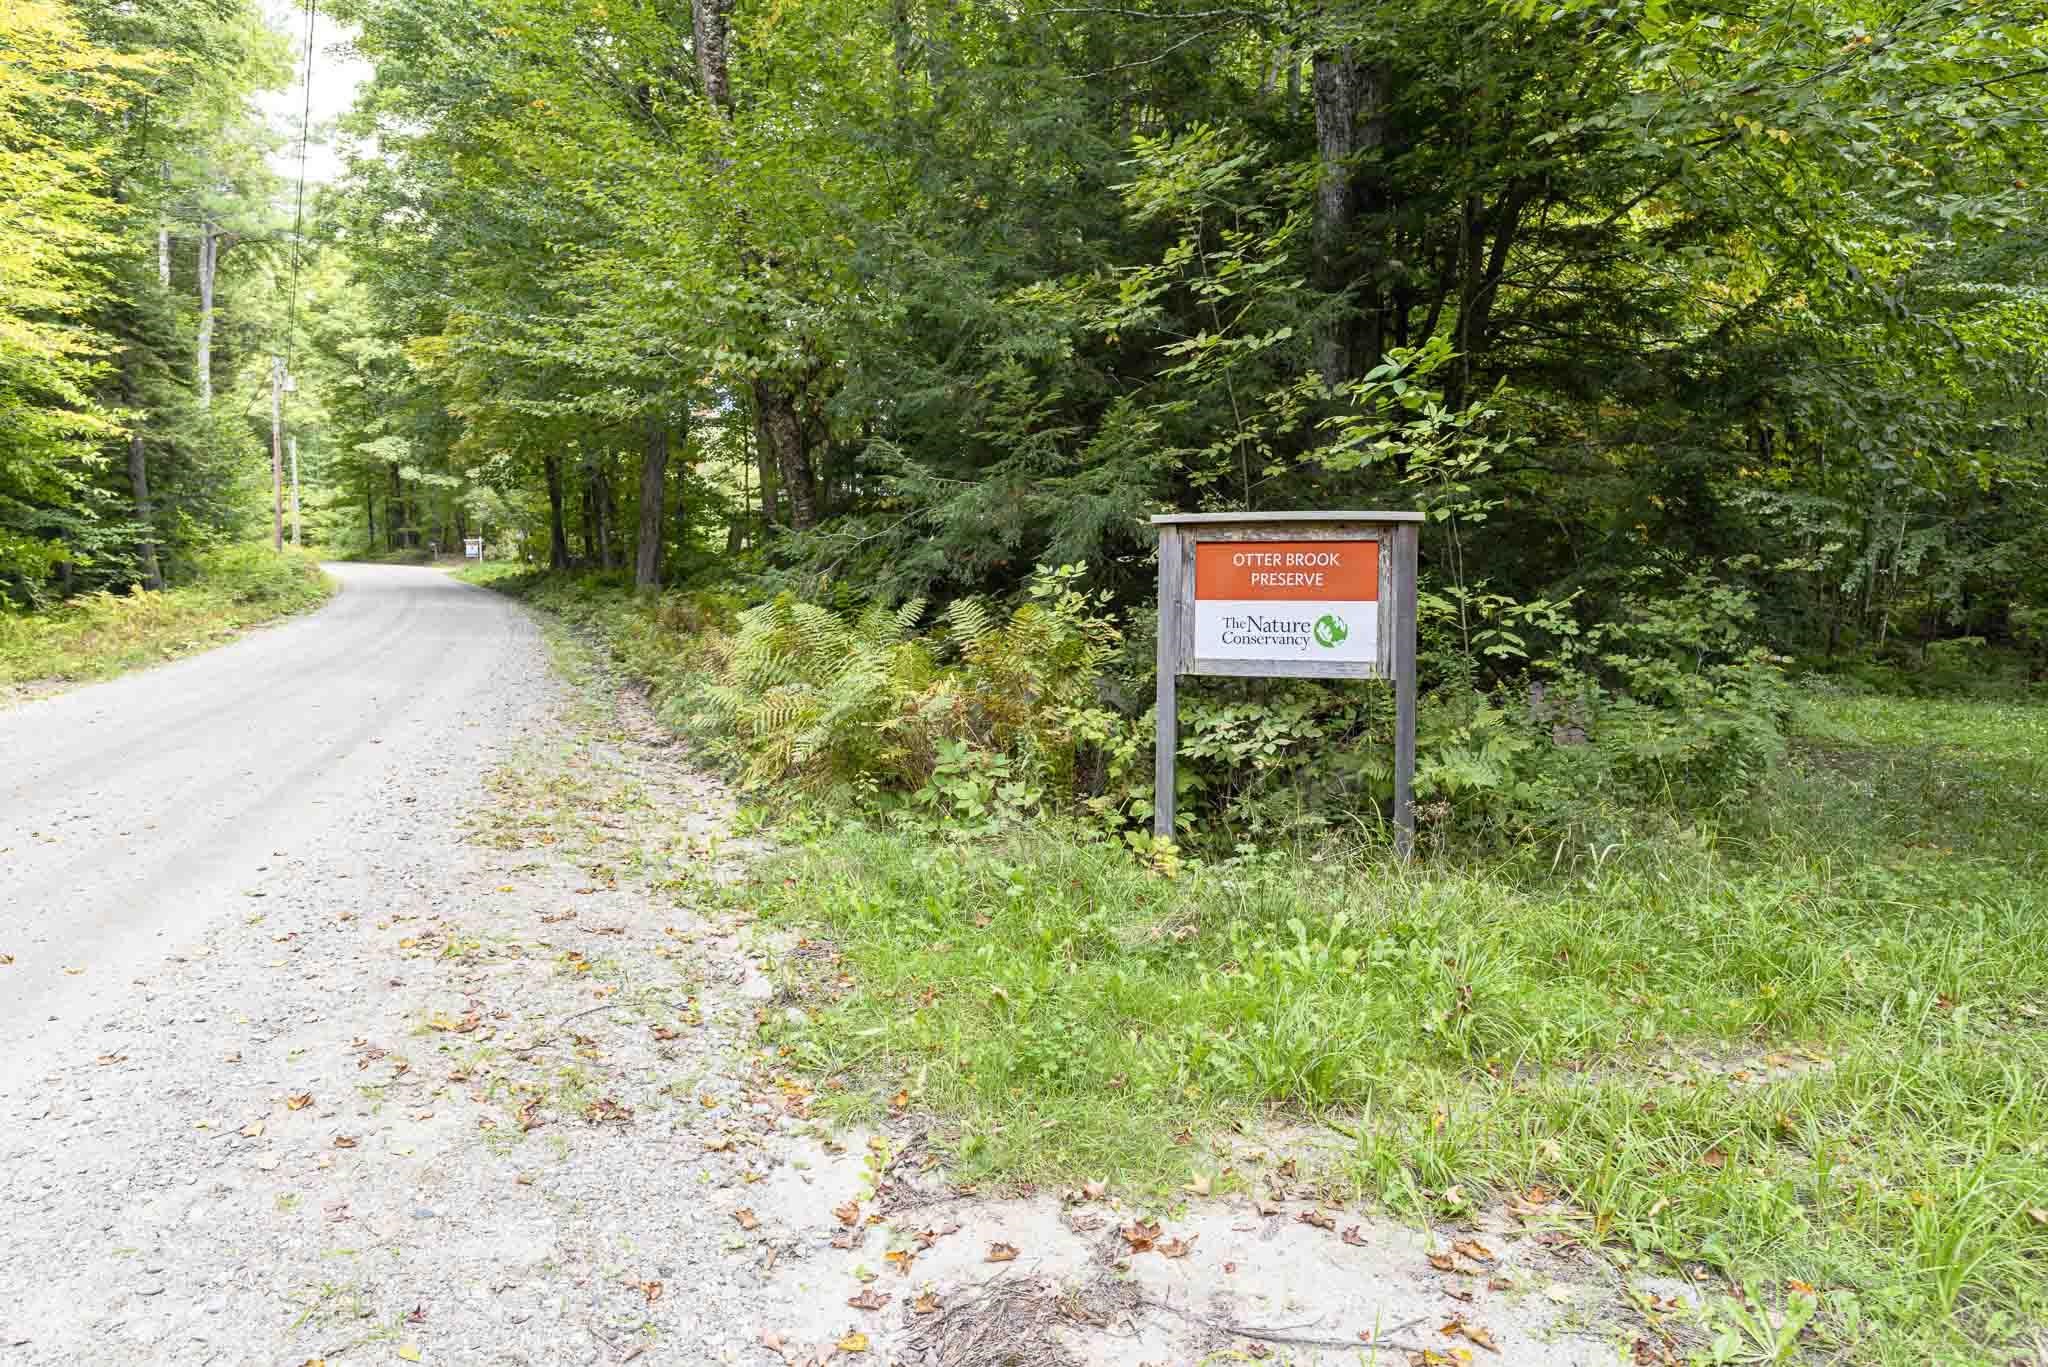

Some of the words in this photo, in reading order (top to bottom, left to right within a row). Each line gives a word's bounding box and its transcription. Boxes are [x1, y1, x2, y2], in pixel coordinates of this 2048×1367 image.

[1233, 553, 1282, 567] OTTER
[1286, 553, 1340, 567] BROOK
[1251, 572, 1324, 586] PRESERVE
[1223, 617, 1247, 630] The
[1247, 615, 1311, 633] Nature
[1222, 631, 1310, 650] Conservancy
